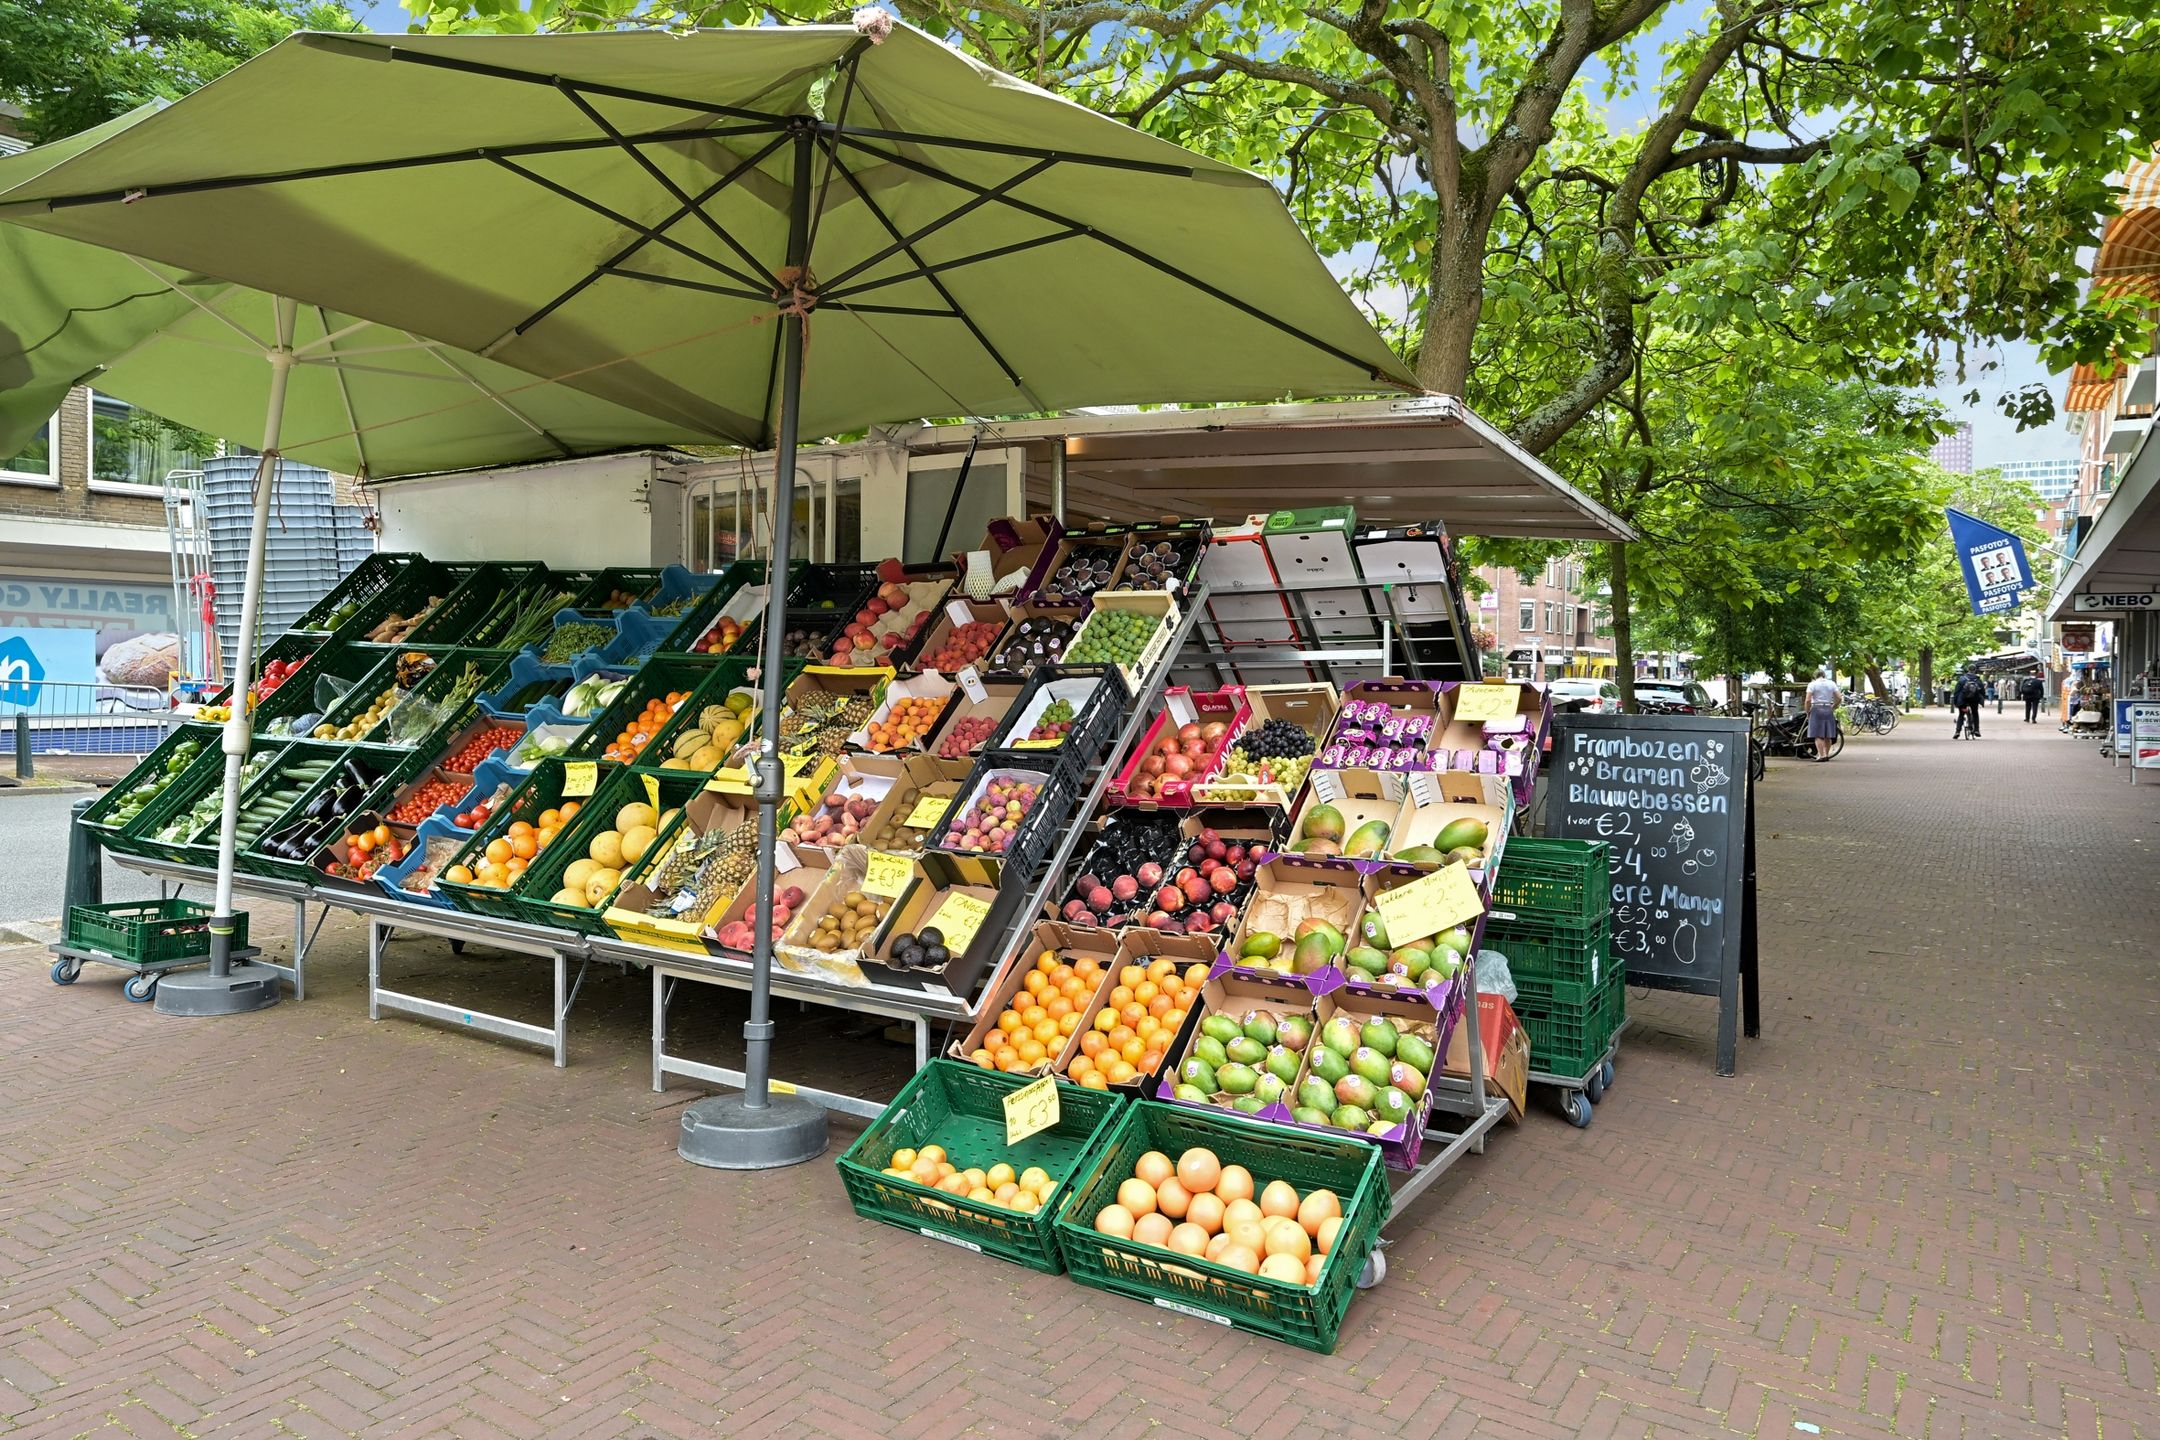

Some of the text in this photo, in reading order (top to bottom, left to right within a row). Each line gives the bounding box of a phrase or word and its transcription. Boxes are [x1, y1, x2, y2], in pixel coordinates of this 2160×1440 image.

[1970, 538, 2010, 554] PASFOTO'S
[1984, 582, 2024, 598] PASFOTO'S
[2102, 595, 2153, 606] NEBO
[1214, 717, 1247, 776] LAVINIA
[1574, 733, 1700, 762] Frambozen
[1596, 760, 1685, 788] Bramen
[1569, 784, 1728, 814] Blauwebessen
[1572, 817, 1592, 825] voor
[1660, 884, 1722, 926] Mango
